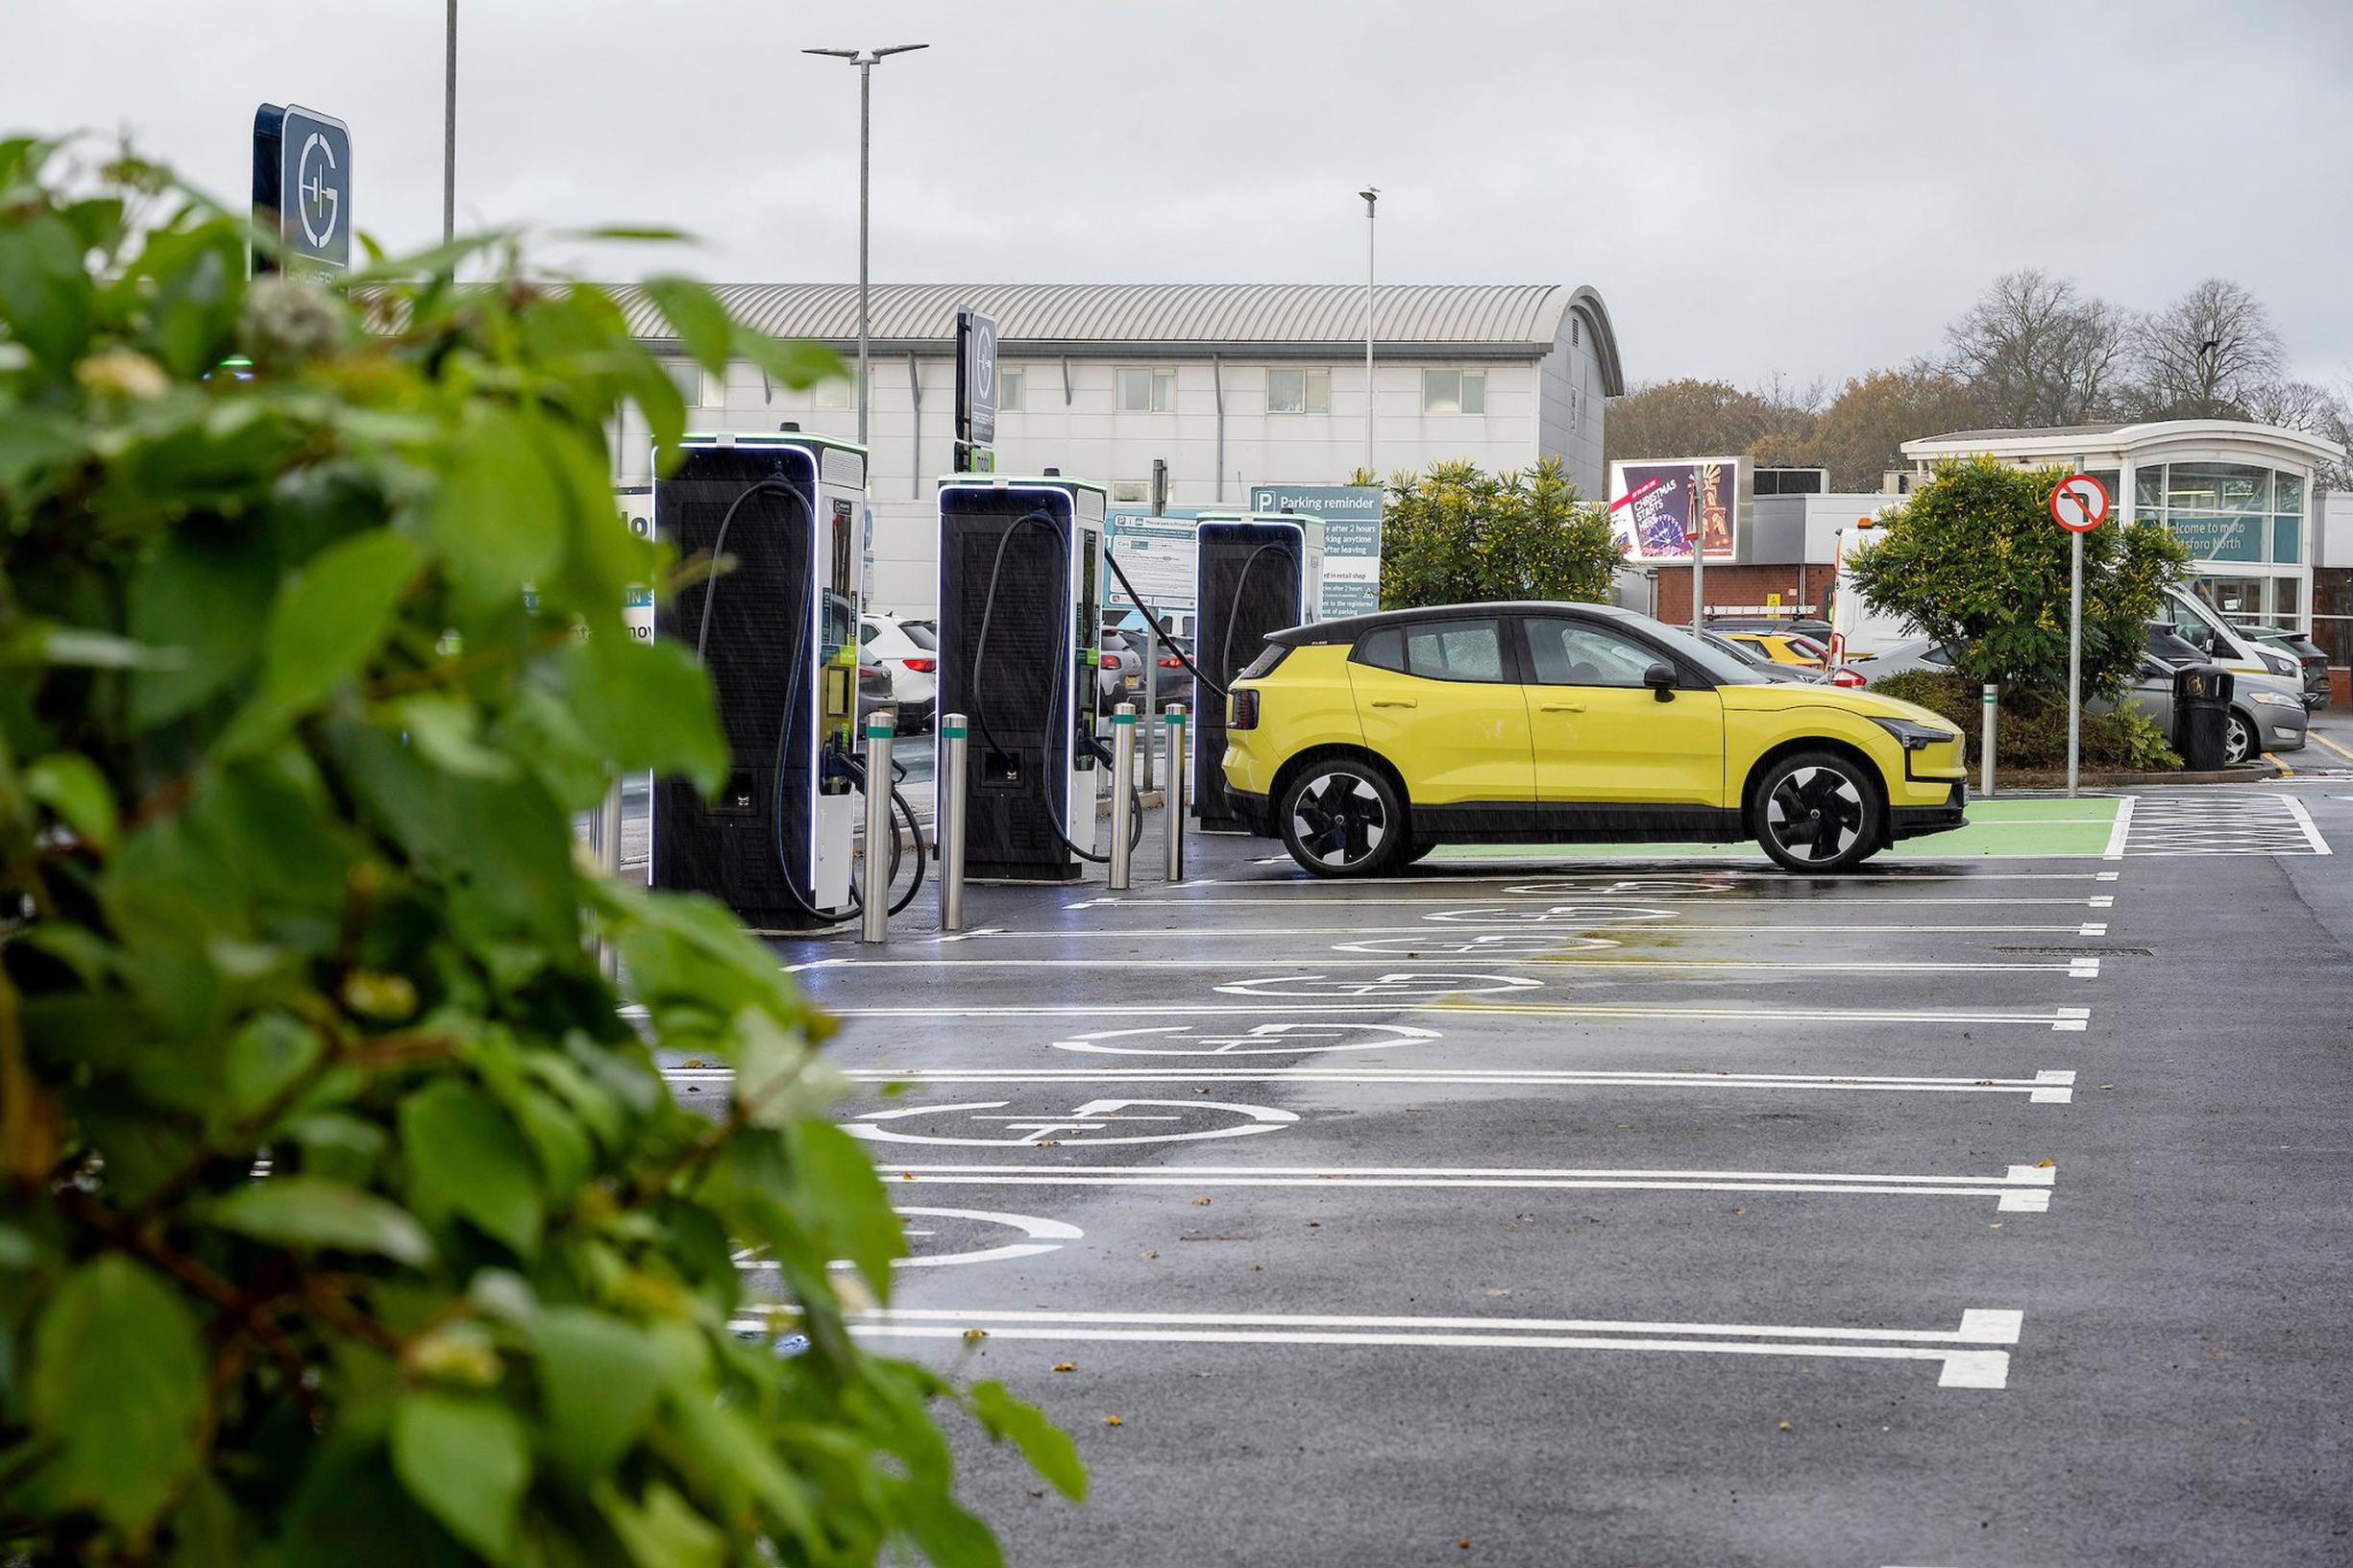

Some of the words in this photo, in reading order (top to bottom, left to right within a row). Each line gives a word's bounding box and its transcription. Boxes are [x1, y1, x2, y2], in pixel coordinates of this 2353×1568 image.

[1634, 478, 1677, 511] CHRISTMAS
[1281, 496, 1322, 510] Parking
[1324, 497, 1375, 509] reminder
[1636, 499, 1664, 522] STARTS
[2169, 522, 2205, 534] elcome
[2208, 523, 2218, 533] to
[1325, 534, 1342, 544] king
[1343, 535, 1372, 544] anytime
[2212, 537, 2242, 550] North
[1341, 546, 1367, 555] leaving
